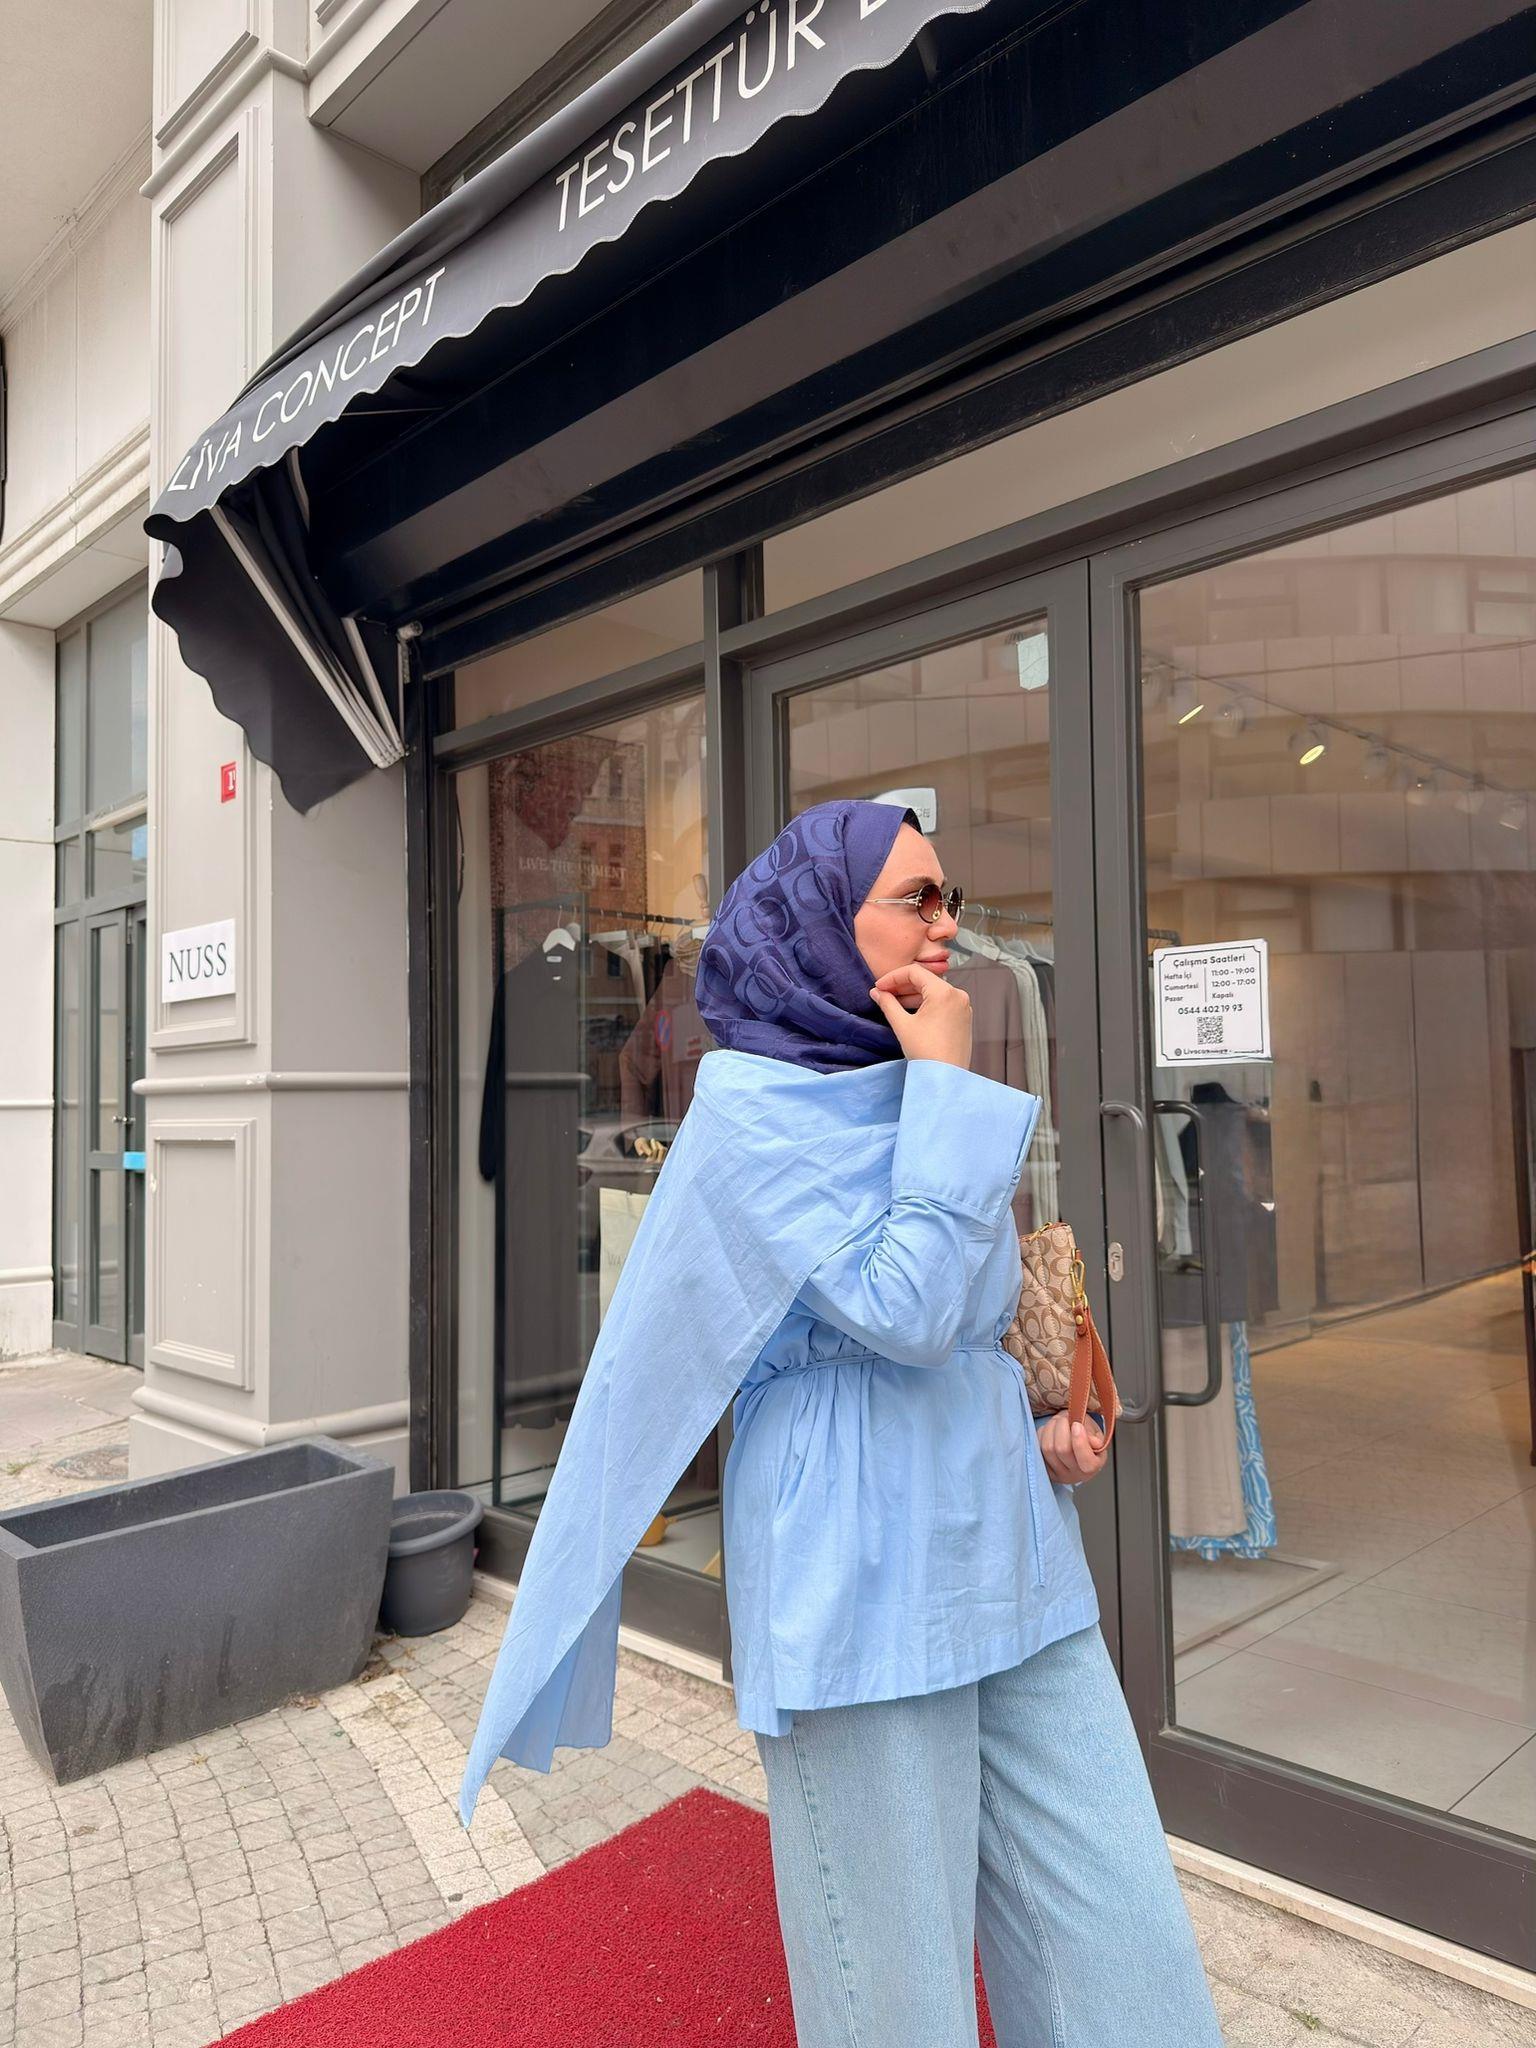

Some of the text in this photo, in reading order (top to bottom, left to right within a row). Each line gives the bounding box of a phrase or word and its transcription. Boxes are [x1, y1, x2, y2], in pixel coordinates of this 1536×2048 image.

[167, 0, 826, 492] LİVA CONCEPT TESETTÜR
[519, 856, 548, 871] LIVE
[168, 942, 227, 983] NUSS
[1173, 953, 1246, 968] Çalışma Saatleri
[1211, 968, 1229, 976] 11:00
[1235, 966, 1255, 975] 19:00
[1164, 983, 1199, 991] Cumartesi
[1211, 980, 1231, 988] 12:00
[1237, 978, 1256, 986] 17:00
[1178, 1003, 1243, 1015] 0544 402 19 93
